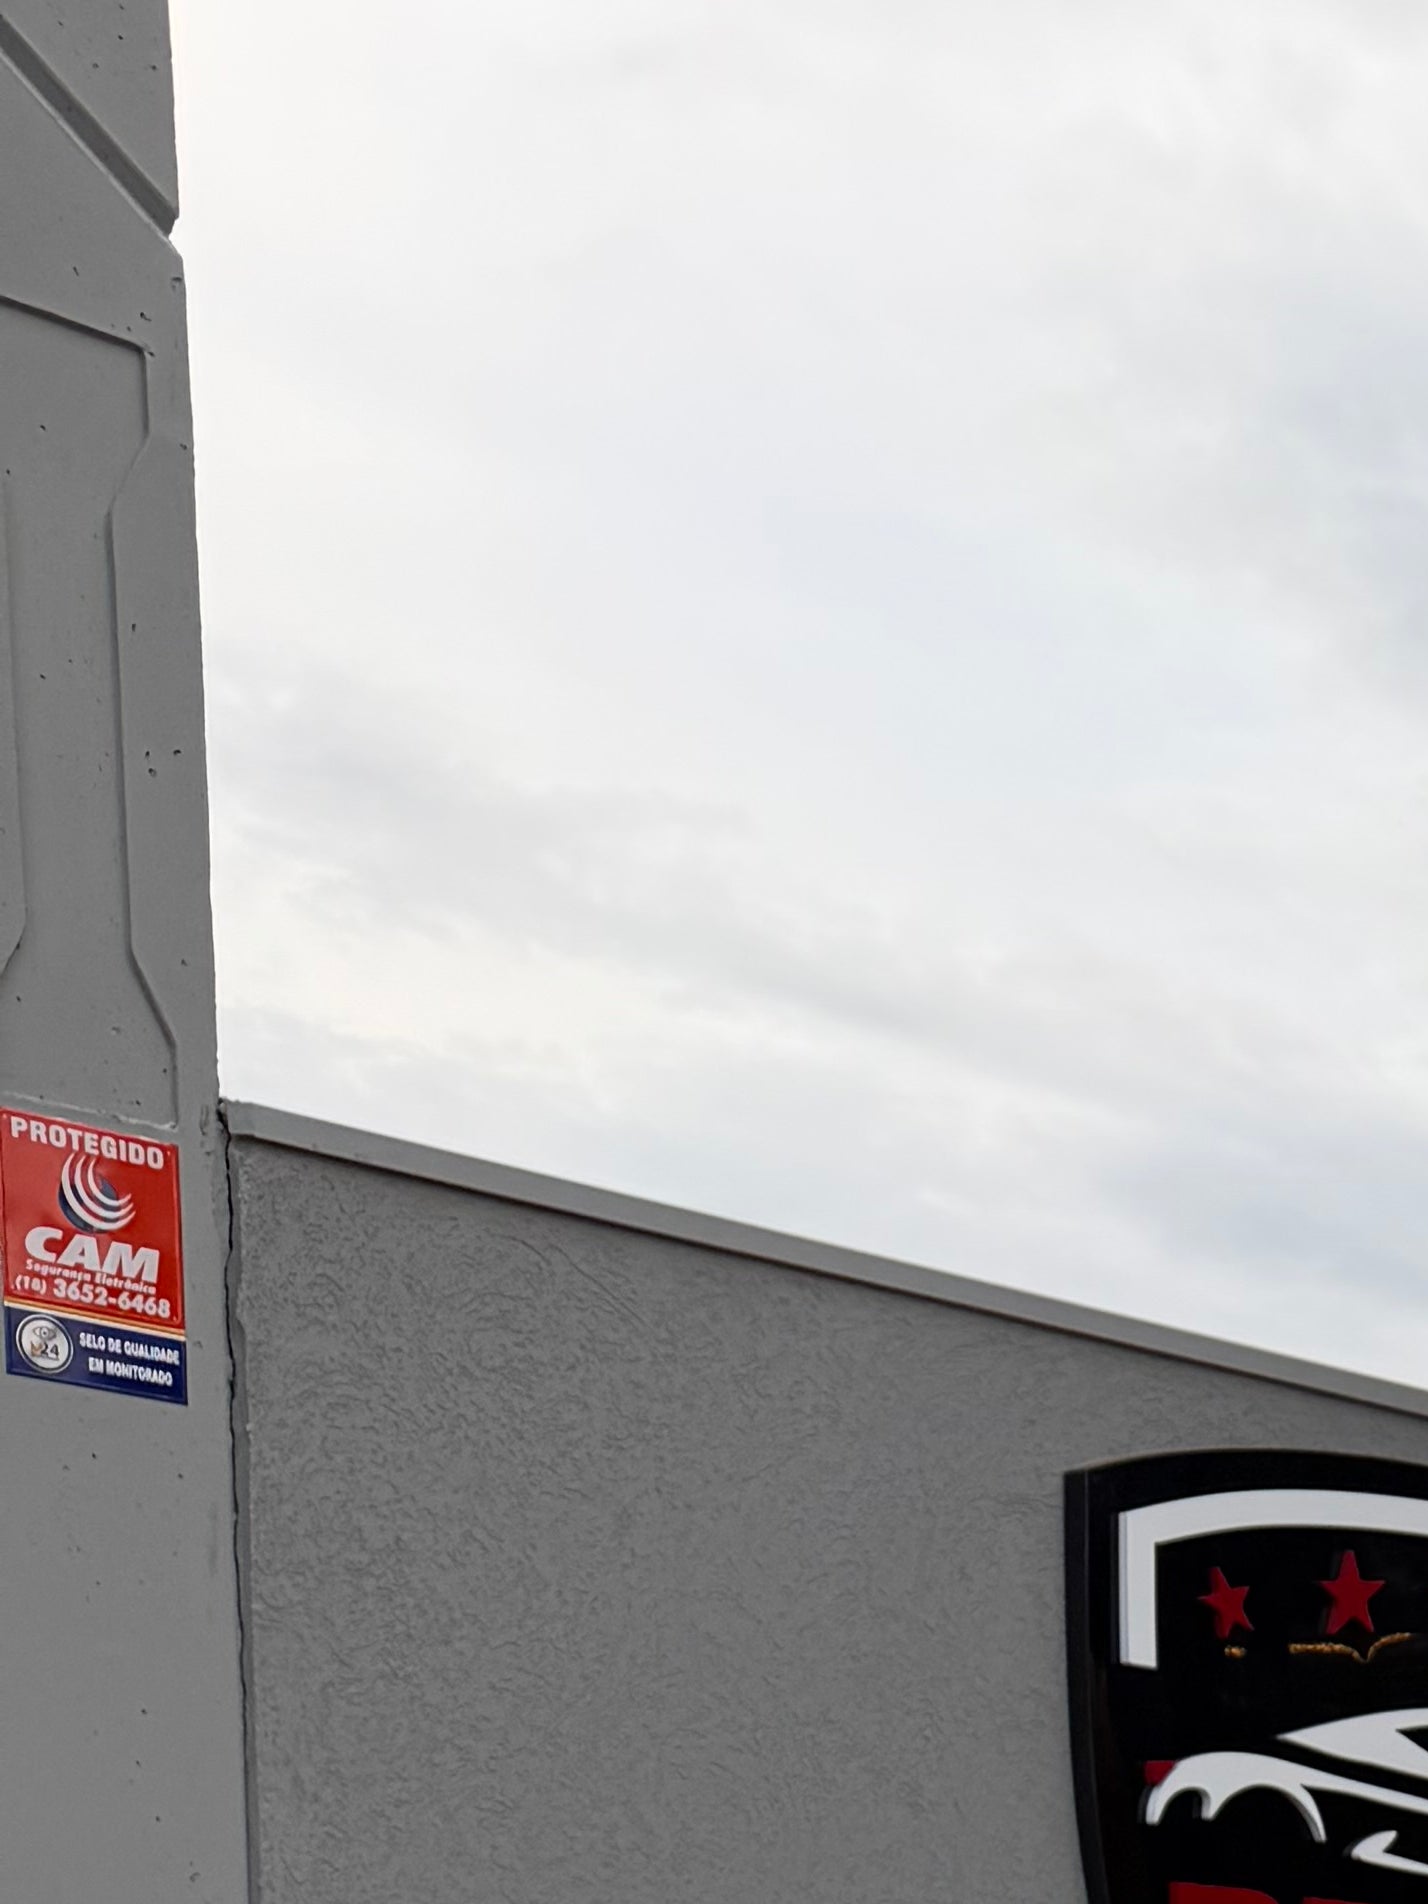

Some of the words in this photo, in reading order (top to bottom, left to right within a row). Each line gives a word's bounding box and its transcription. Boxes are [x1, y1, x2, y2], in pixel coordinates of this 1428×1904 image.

[10, 1115, 164, 1170] PROTEGIDO
[24, 1225, 160, 1284] CAM
[25, 1259, 91, 1283] Segurança
[15, 1274, 47, 1295] (18)
[53, 1278, 171, 1318] 3652-6468
[79, 1332, 106, 1350] SELO
[107, 1337, 122, 1354] DE
[124, 1340, 180, 1365] QUALIDADE
[106, 1360, 173, 1386] MONITORADO
